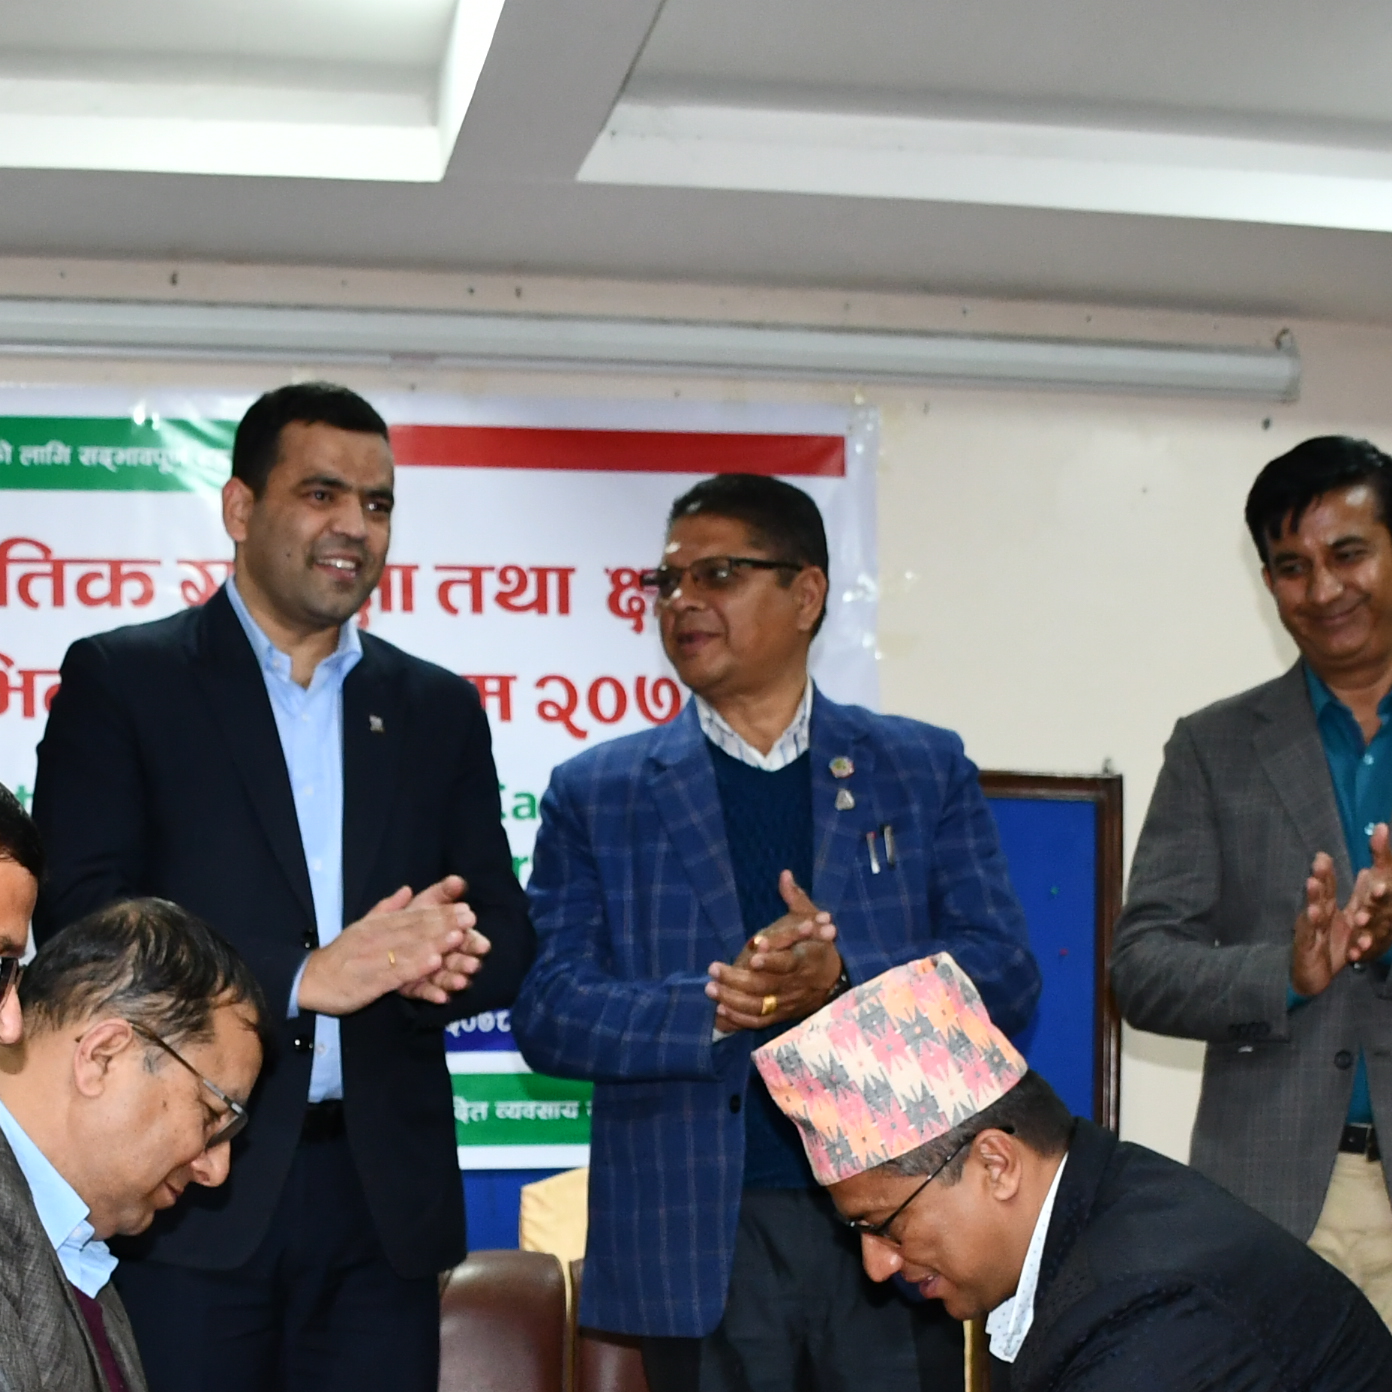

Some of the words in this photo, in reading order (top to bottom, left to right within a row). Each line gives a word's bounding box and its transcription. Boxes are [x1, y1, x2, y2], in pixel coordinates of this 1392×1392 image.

[435, 564, 576, 616] तथा
[534, 674, 682, 740] २०७
[494, 1100, 580, 1120] व्यवसाय
